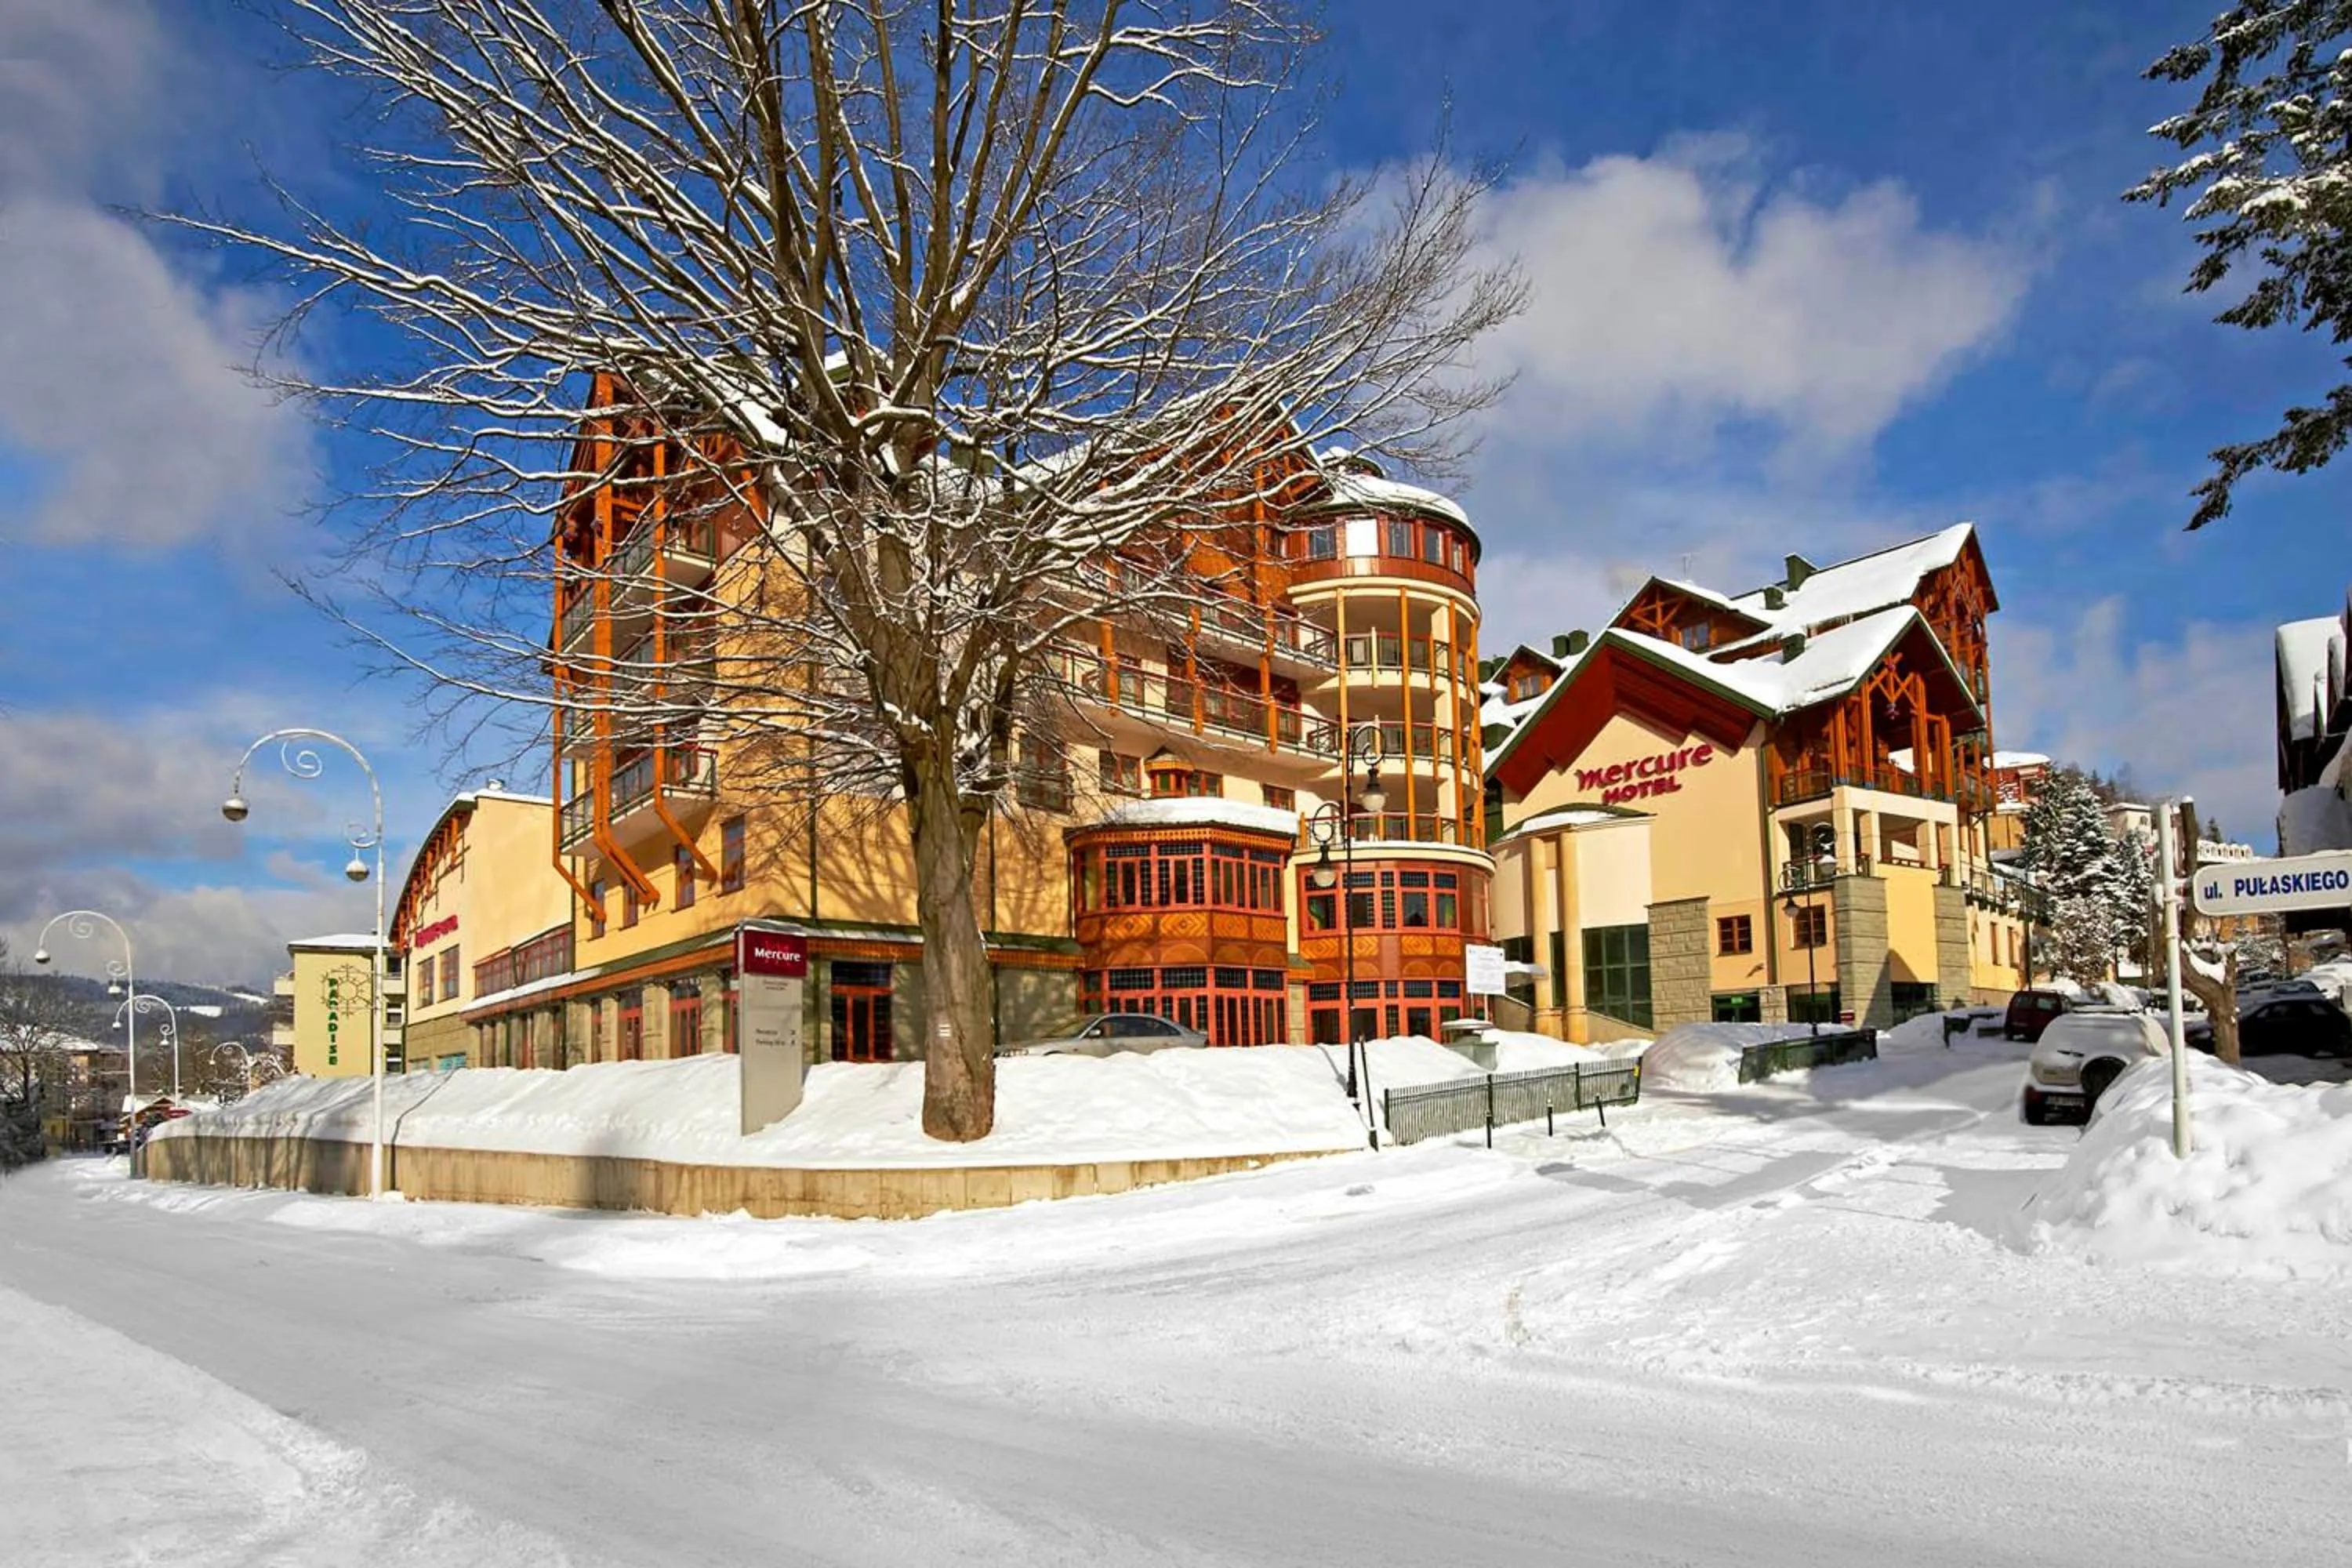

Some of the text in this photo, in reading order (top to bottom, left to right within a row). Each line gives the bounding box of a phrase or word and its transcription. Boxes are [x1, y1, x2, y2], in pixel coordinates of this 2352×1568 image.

[1602, 776, 1682, 806] HOTEL
[2204, 870, 2349, 899] ul. PUŁASKIEGO
[755, 947, 800, 962] Mercure
